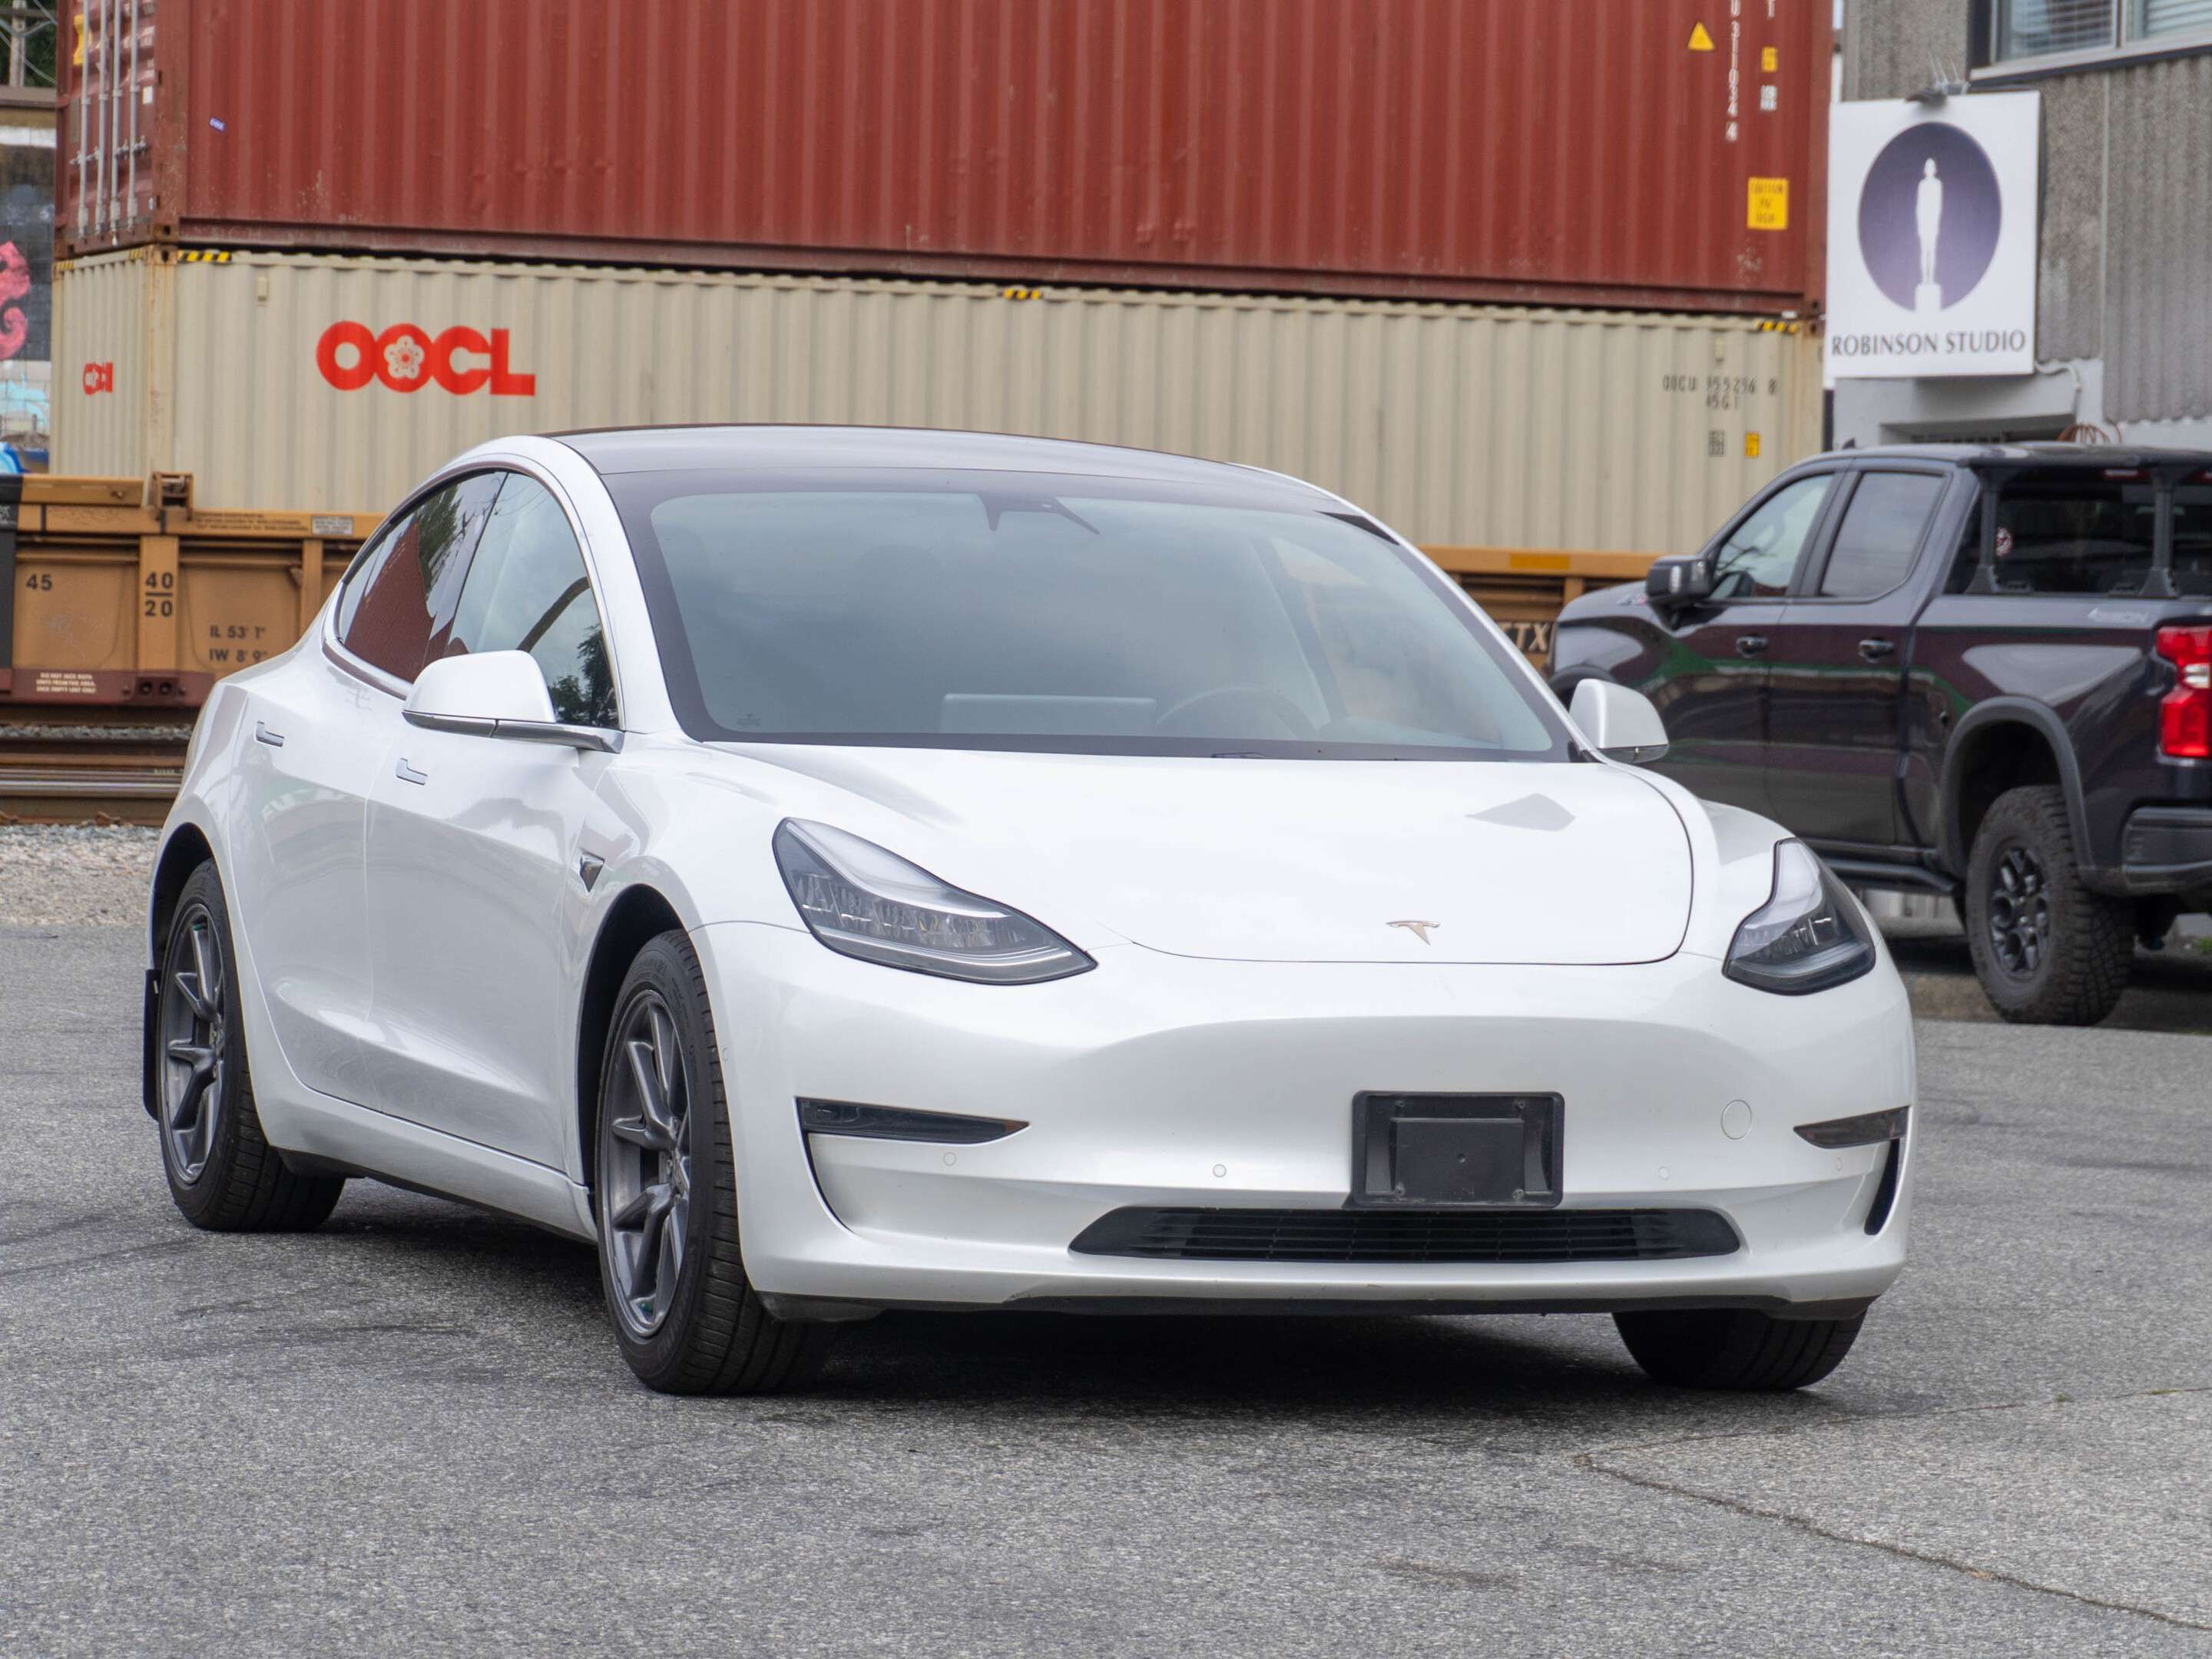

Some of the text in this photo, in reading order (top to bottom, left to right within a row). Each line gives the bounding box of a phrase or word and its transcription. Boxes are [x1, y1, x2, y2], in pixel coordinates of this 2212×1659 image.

[1831, 329, 2026, 356] ROBINSON STUDIO
[316, 320, 535, 396] OOCL
[26, 574, 53, 591] 45
[145, 572, 174, 589] 40
[144, 600, 174, 618] 20
[210, 624, 221, 639] IL
[209, 648, 229, 662] IW
